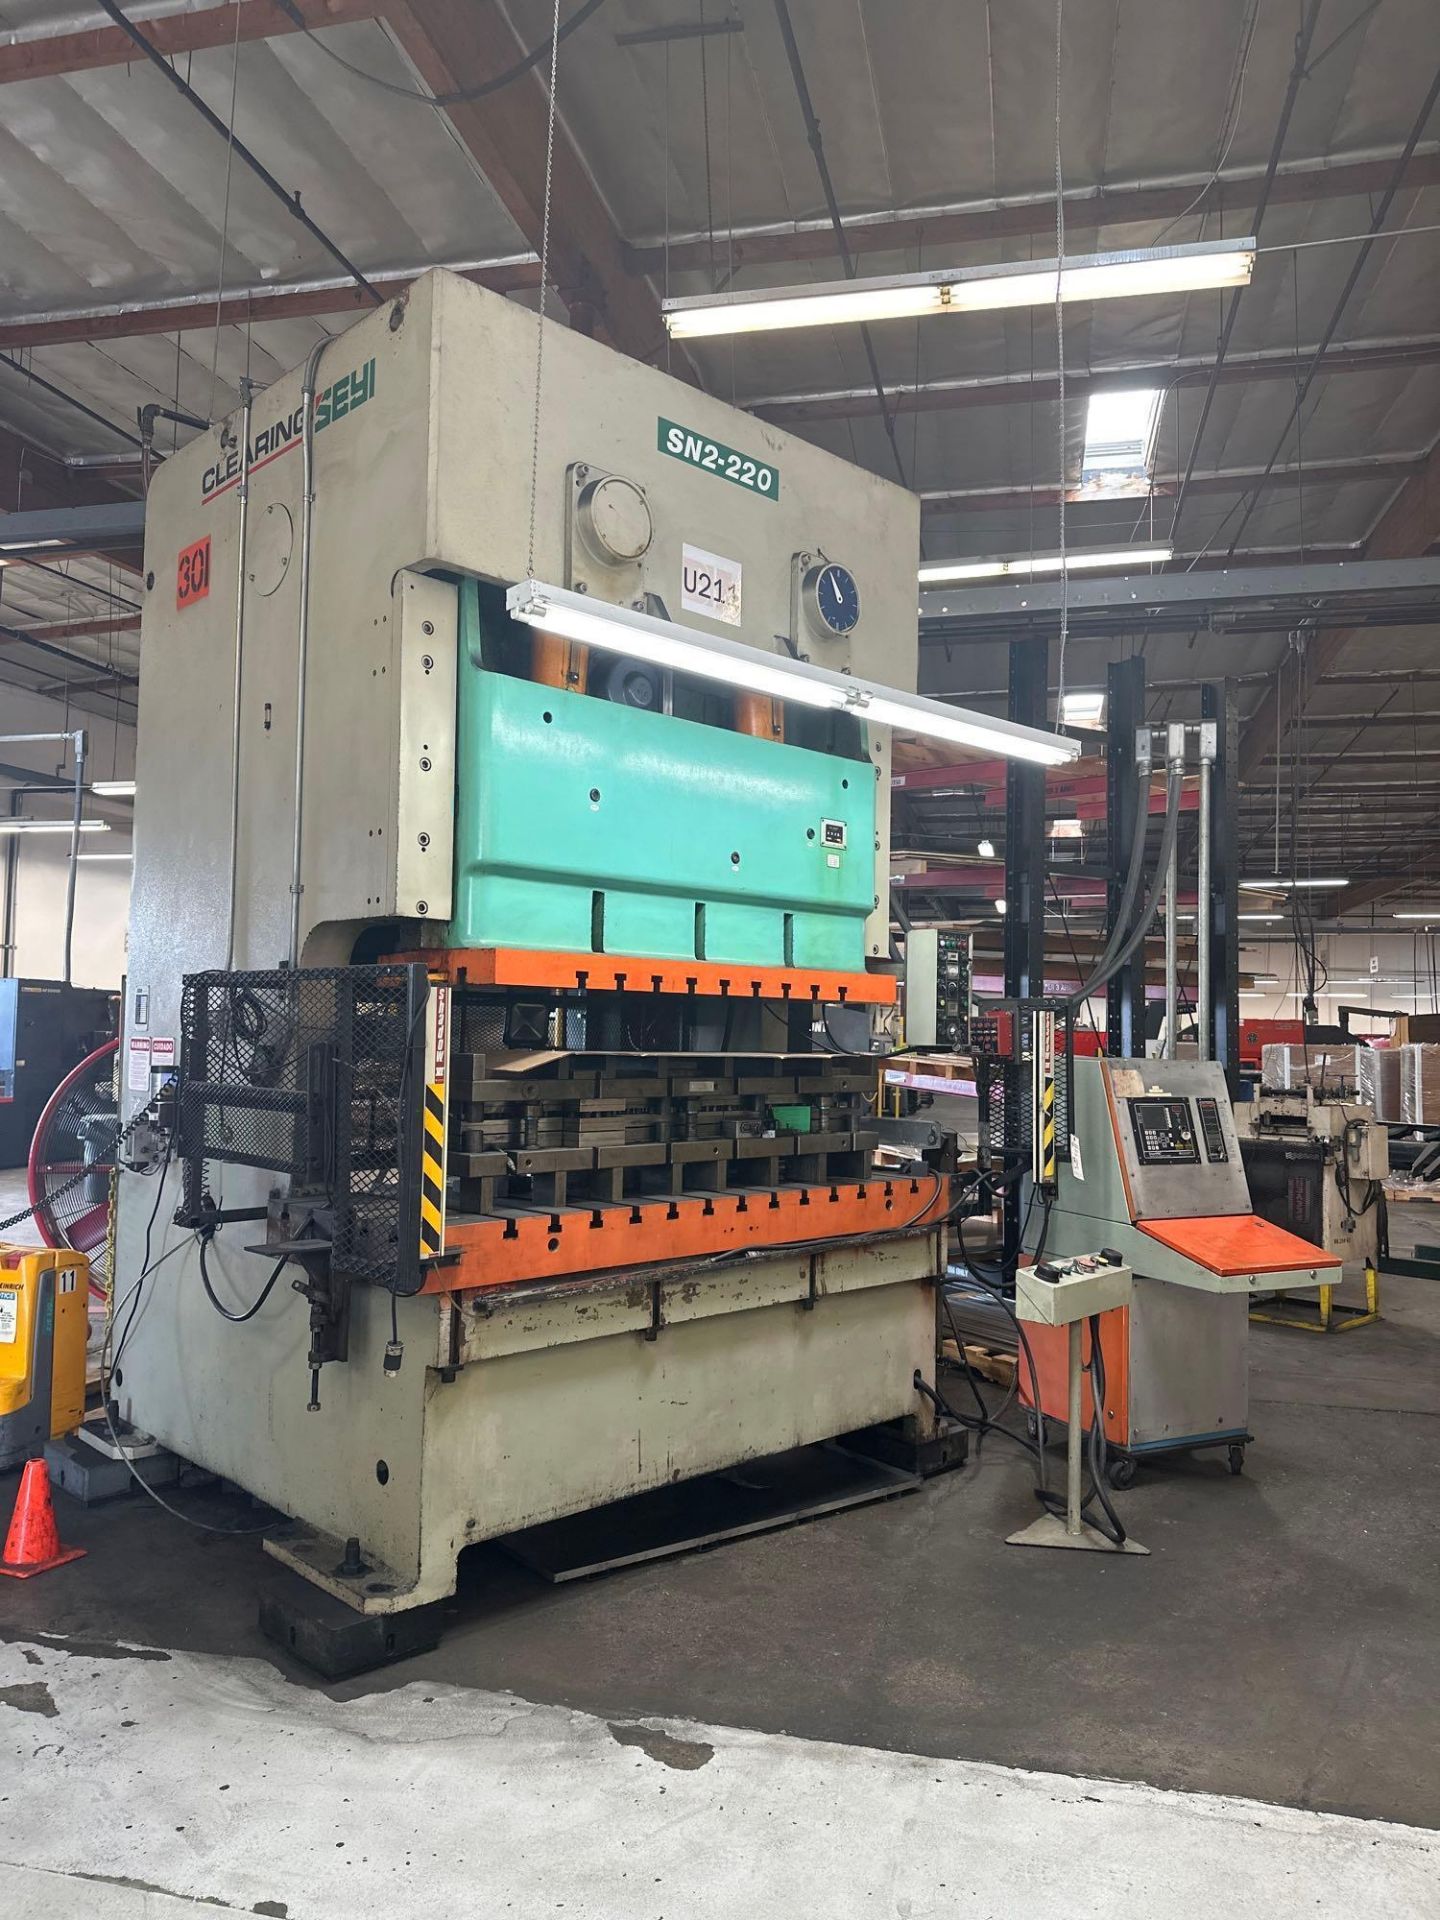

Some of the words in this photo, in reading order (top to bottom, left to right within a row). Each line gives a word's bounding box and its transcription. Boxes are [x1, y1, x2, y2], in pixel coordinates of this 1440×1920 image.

[314, 358, 376, 433] SEYI
[667, 428, 772, 491] SN2-220
[178, 543, 210, 598] 301
[62, 1270, 75, 1292] 11
